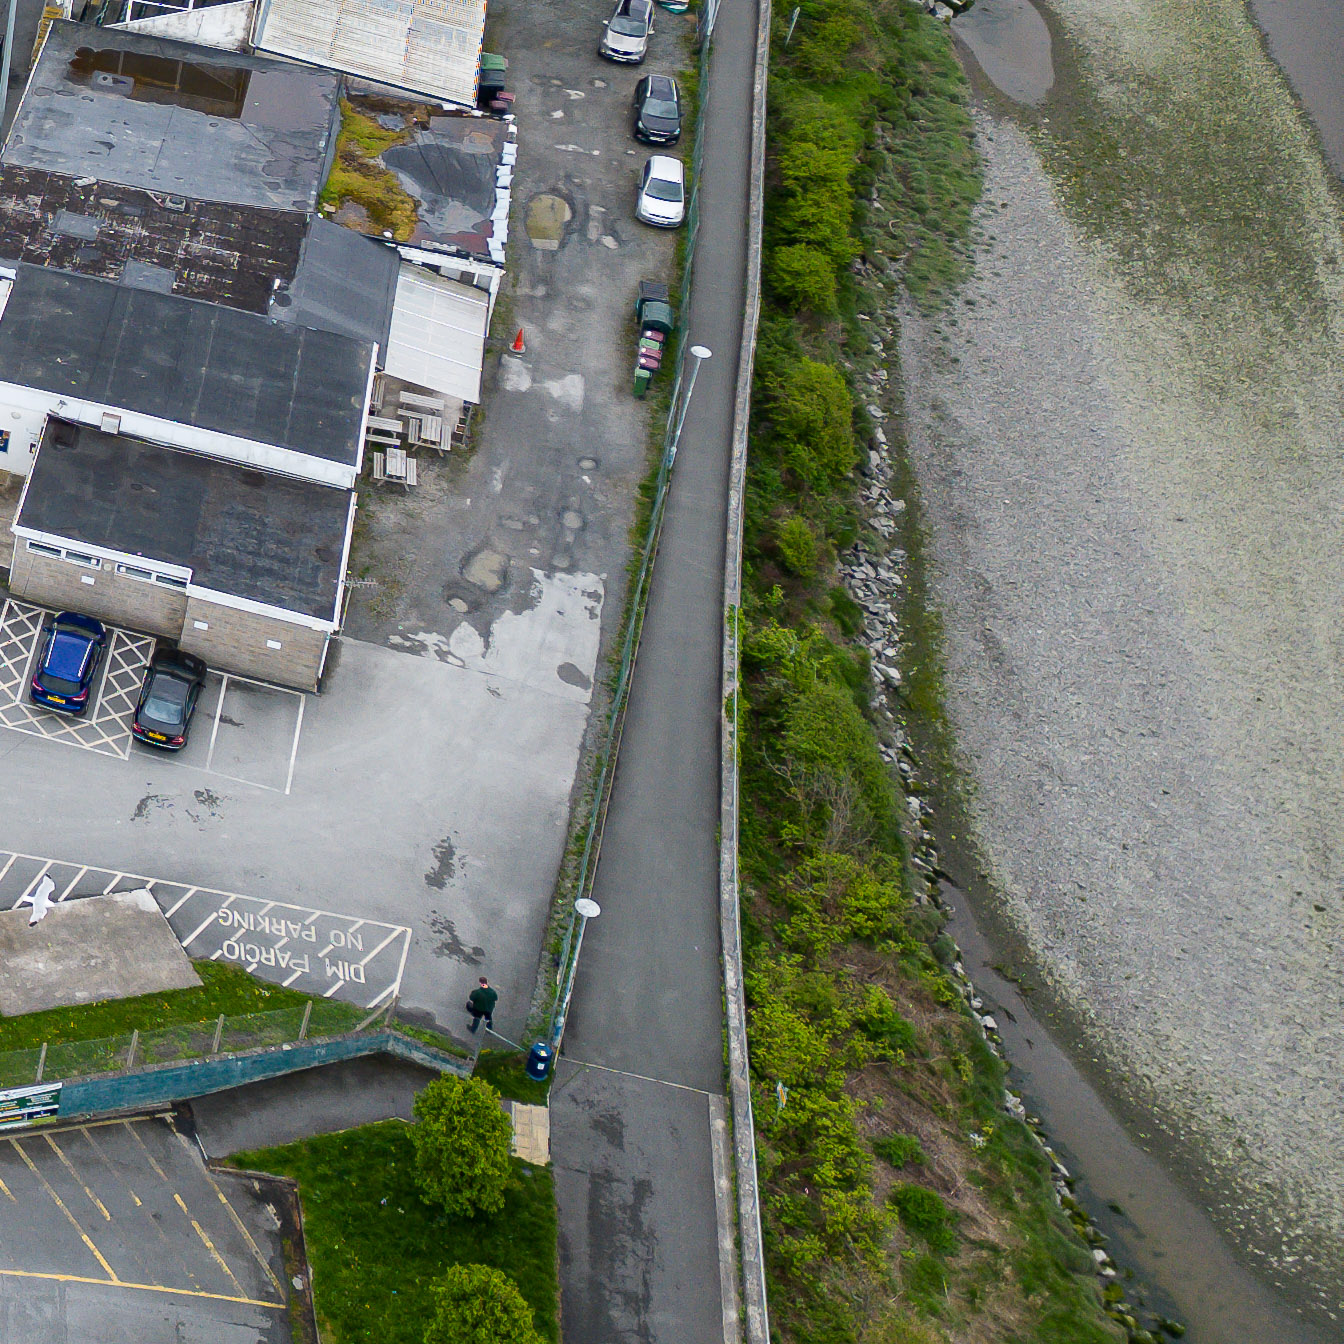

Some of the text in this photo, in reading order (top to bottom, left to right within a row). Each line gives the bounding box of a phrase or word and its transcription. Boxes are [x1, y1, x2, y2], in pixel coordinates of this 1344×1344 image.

[218, 908, 364, 952] NO PARKING
[222, 939, 366, 984] DIM PARCIO
